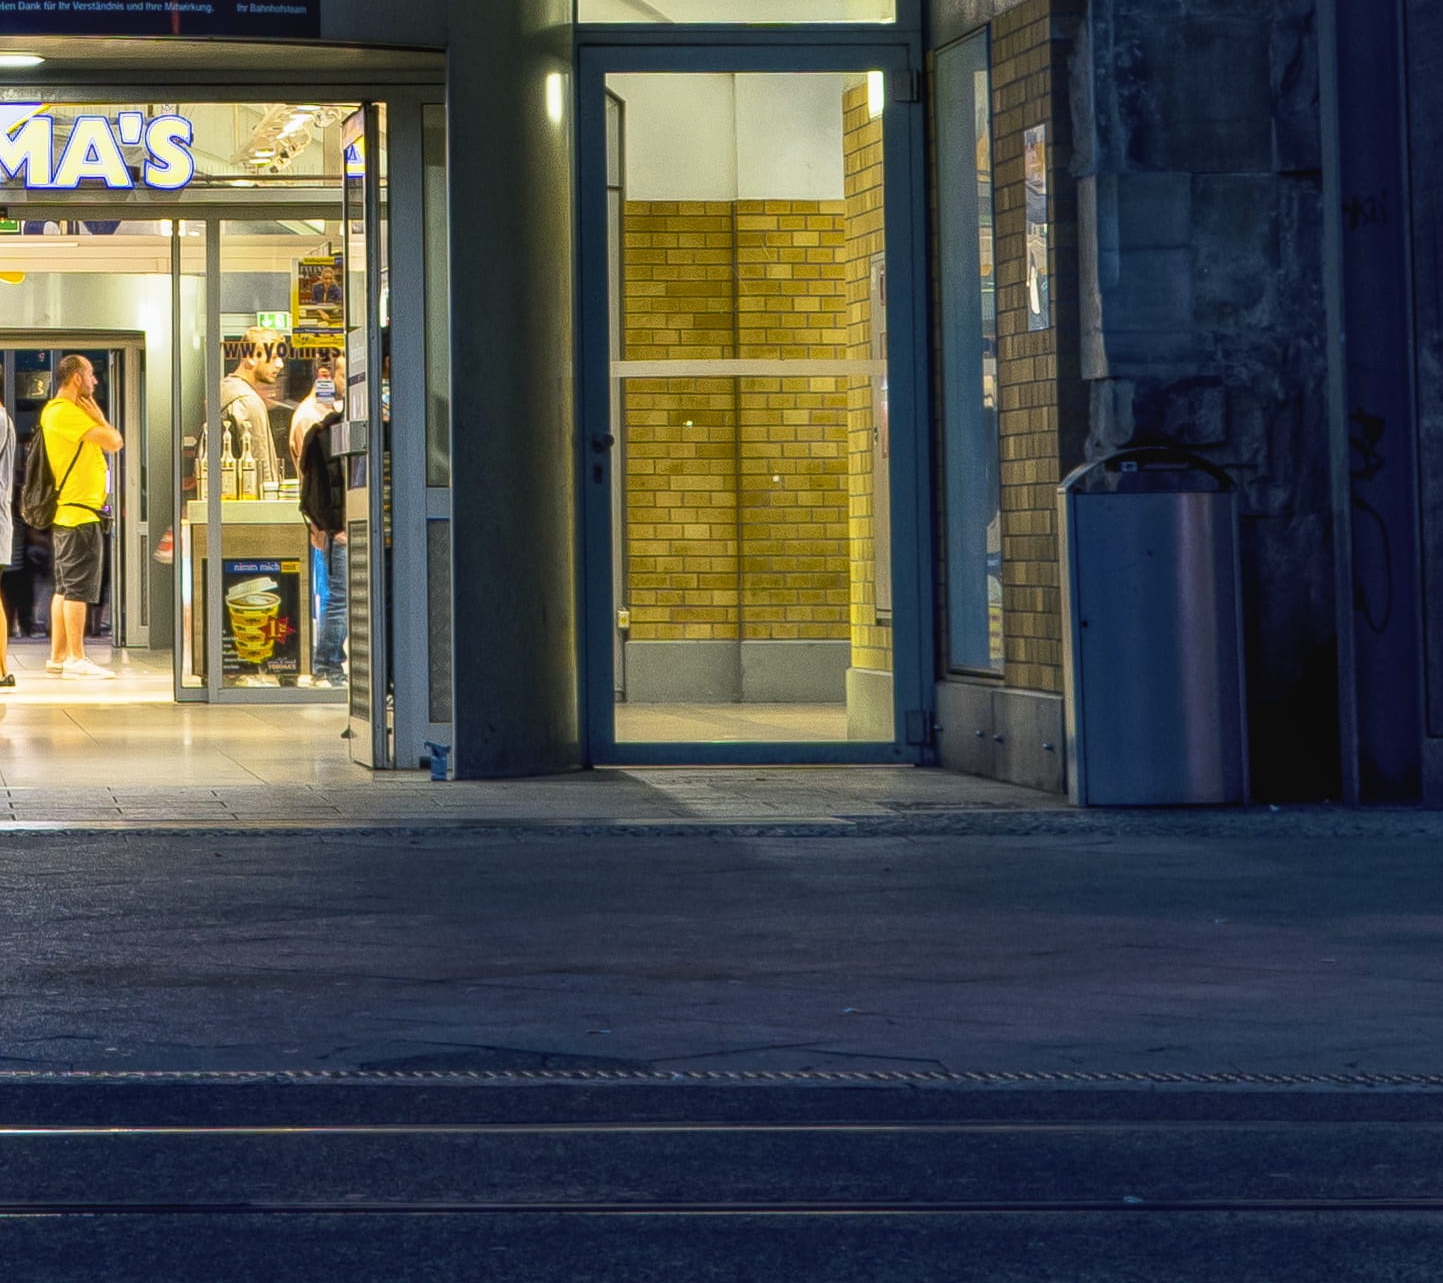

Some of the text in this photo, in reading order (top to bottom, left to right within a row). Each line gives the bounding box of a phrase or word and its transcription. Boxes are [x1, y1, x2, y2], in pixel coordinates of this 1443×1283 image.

[18, 1, 41, 11] Dank
[43, 1, 57, 11] für
[58, 2, 71, 11] Ihr
[72, 1, 124, 11] Verständnis
[126, 2, 143, 11] und
[145, 2, 162, 11] Ihre
[165, 2, 214, 14] Mitwirkung.
[237, 3, 307, 14] Ihr Bahnhofsteam
